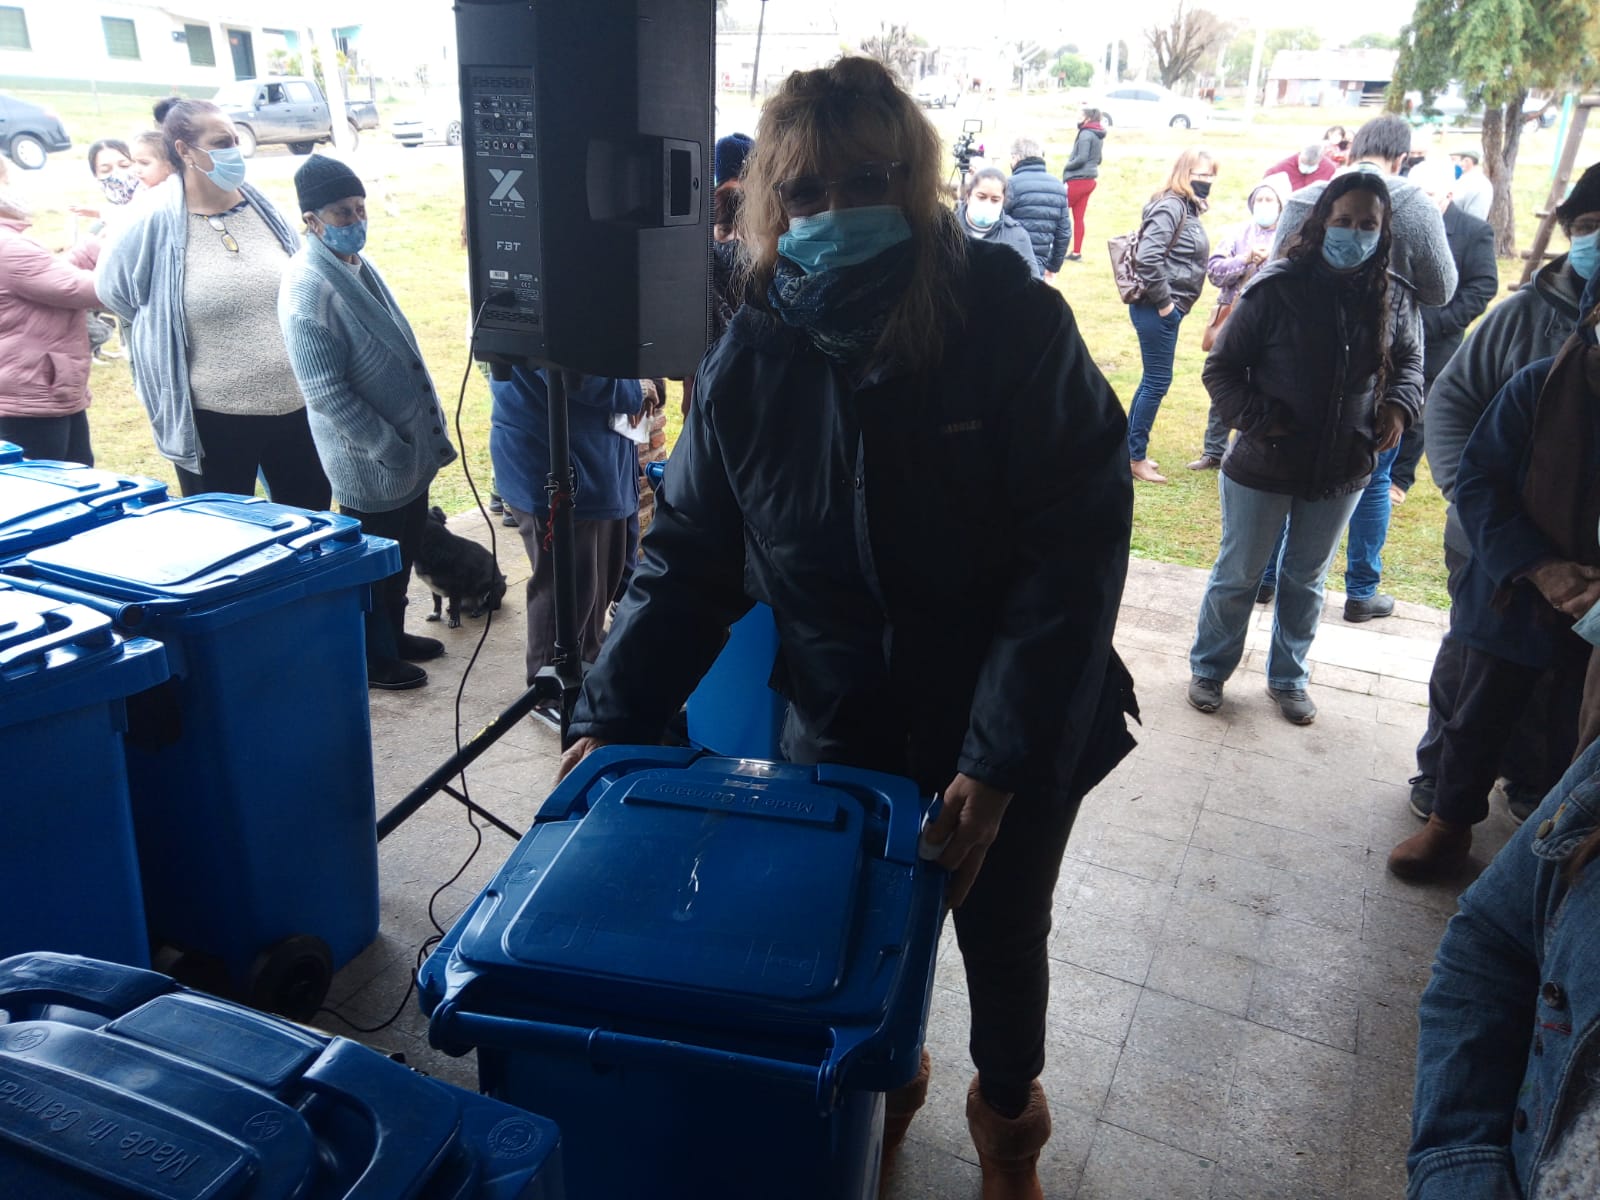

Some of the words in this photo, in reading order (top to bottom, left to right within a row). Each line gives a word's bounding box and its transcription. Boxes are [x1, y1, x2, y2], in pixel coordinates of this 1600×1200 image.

[488, 168, 524, 200] X
[488, 199, 526, 209] LITE
[496, 240, 521, 252] FBT
[88, 1118, 120, 1148] in
[120, 1130, 200, 1181] Made
